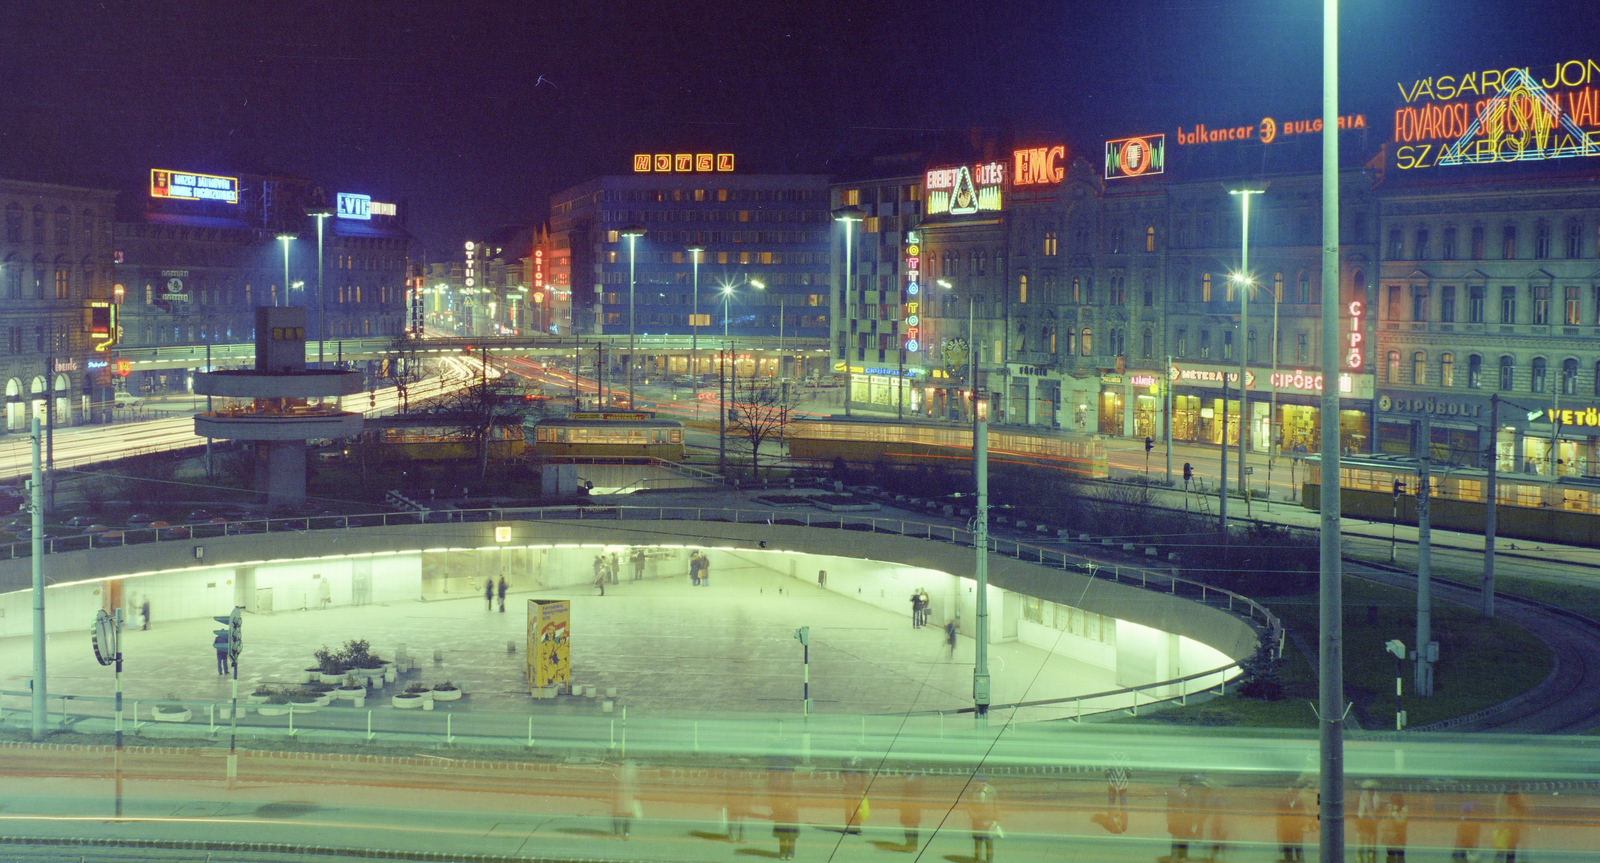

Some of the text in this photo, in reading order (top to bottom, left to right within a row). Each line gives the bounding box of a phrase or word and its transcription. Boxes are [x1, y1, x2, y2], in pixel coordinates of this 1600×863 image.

[1177, 113, 1366, 146] balkancar BULGRIA
[1394, 102, 1469, 142] FŐVÁROSI
[634, 153, 735, 173] HOTEL
[1013, 146, 1065, 186] EMG
[535, 250, 543, 287] ORION
[1349, 301, 1362, 368] CIPŐ
[1394, 396, 1482, 417] CIPŐBOLT
[1548, 407, 1600, 428] VETŐ
